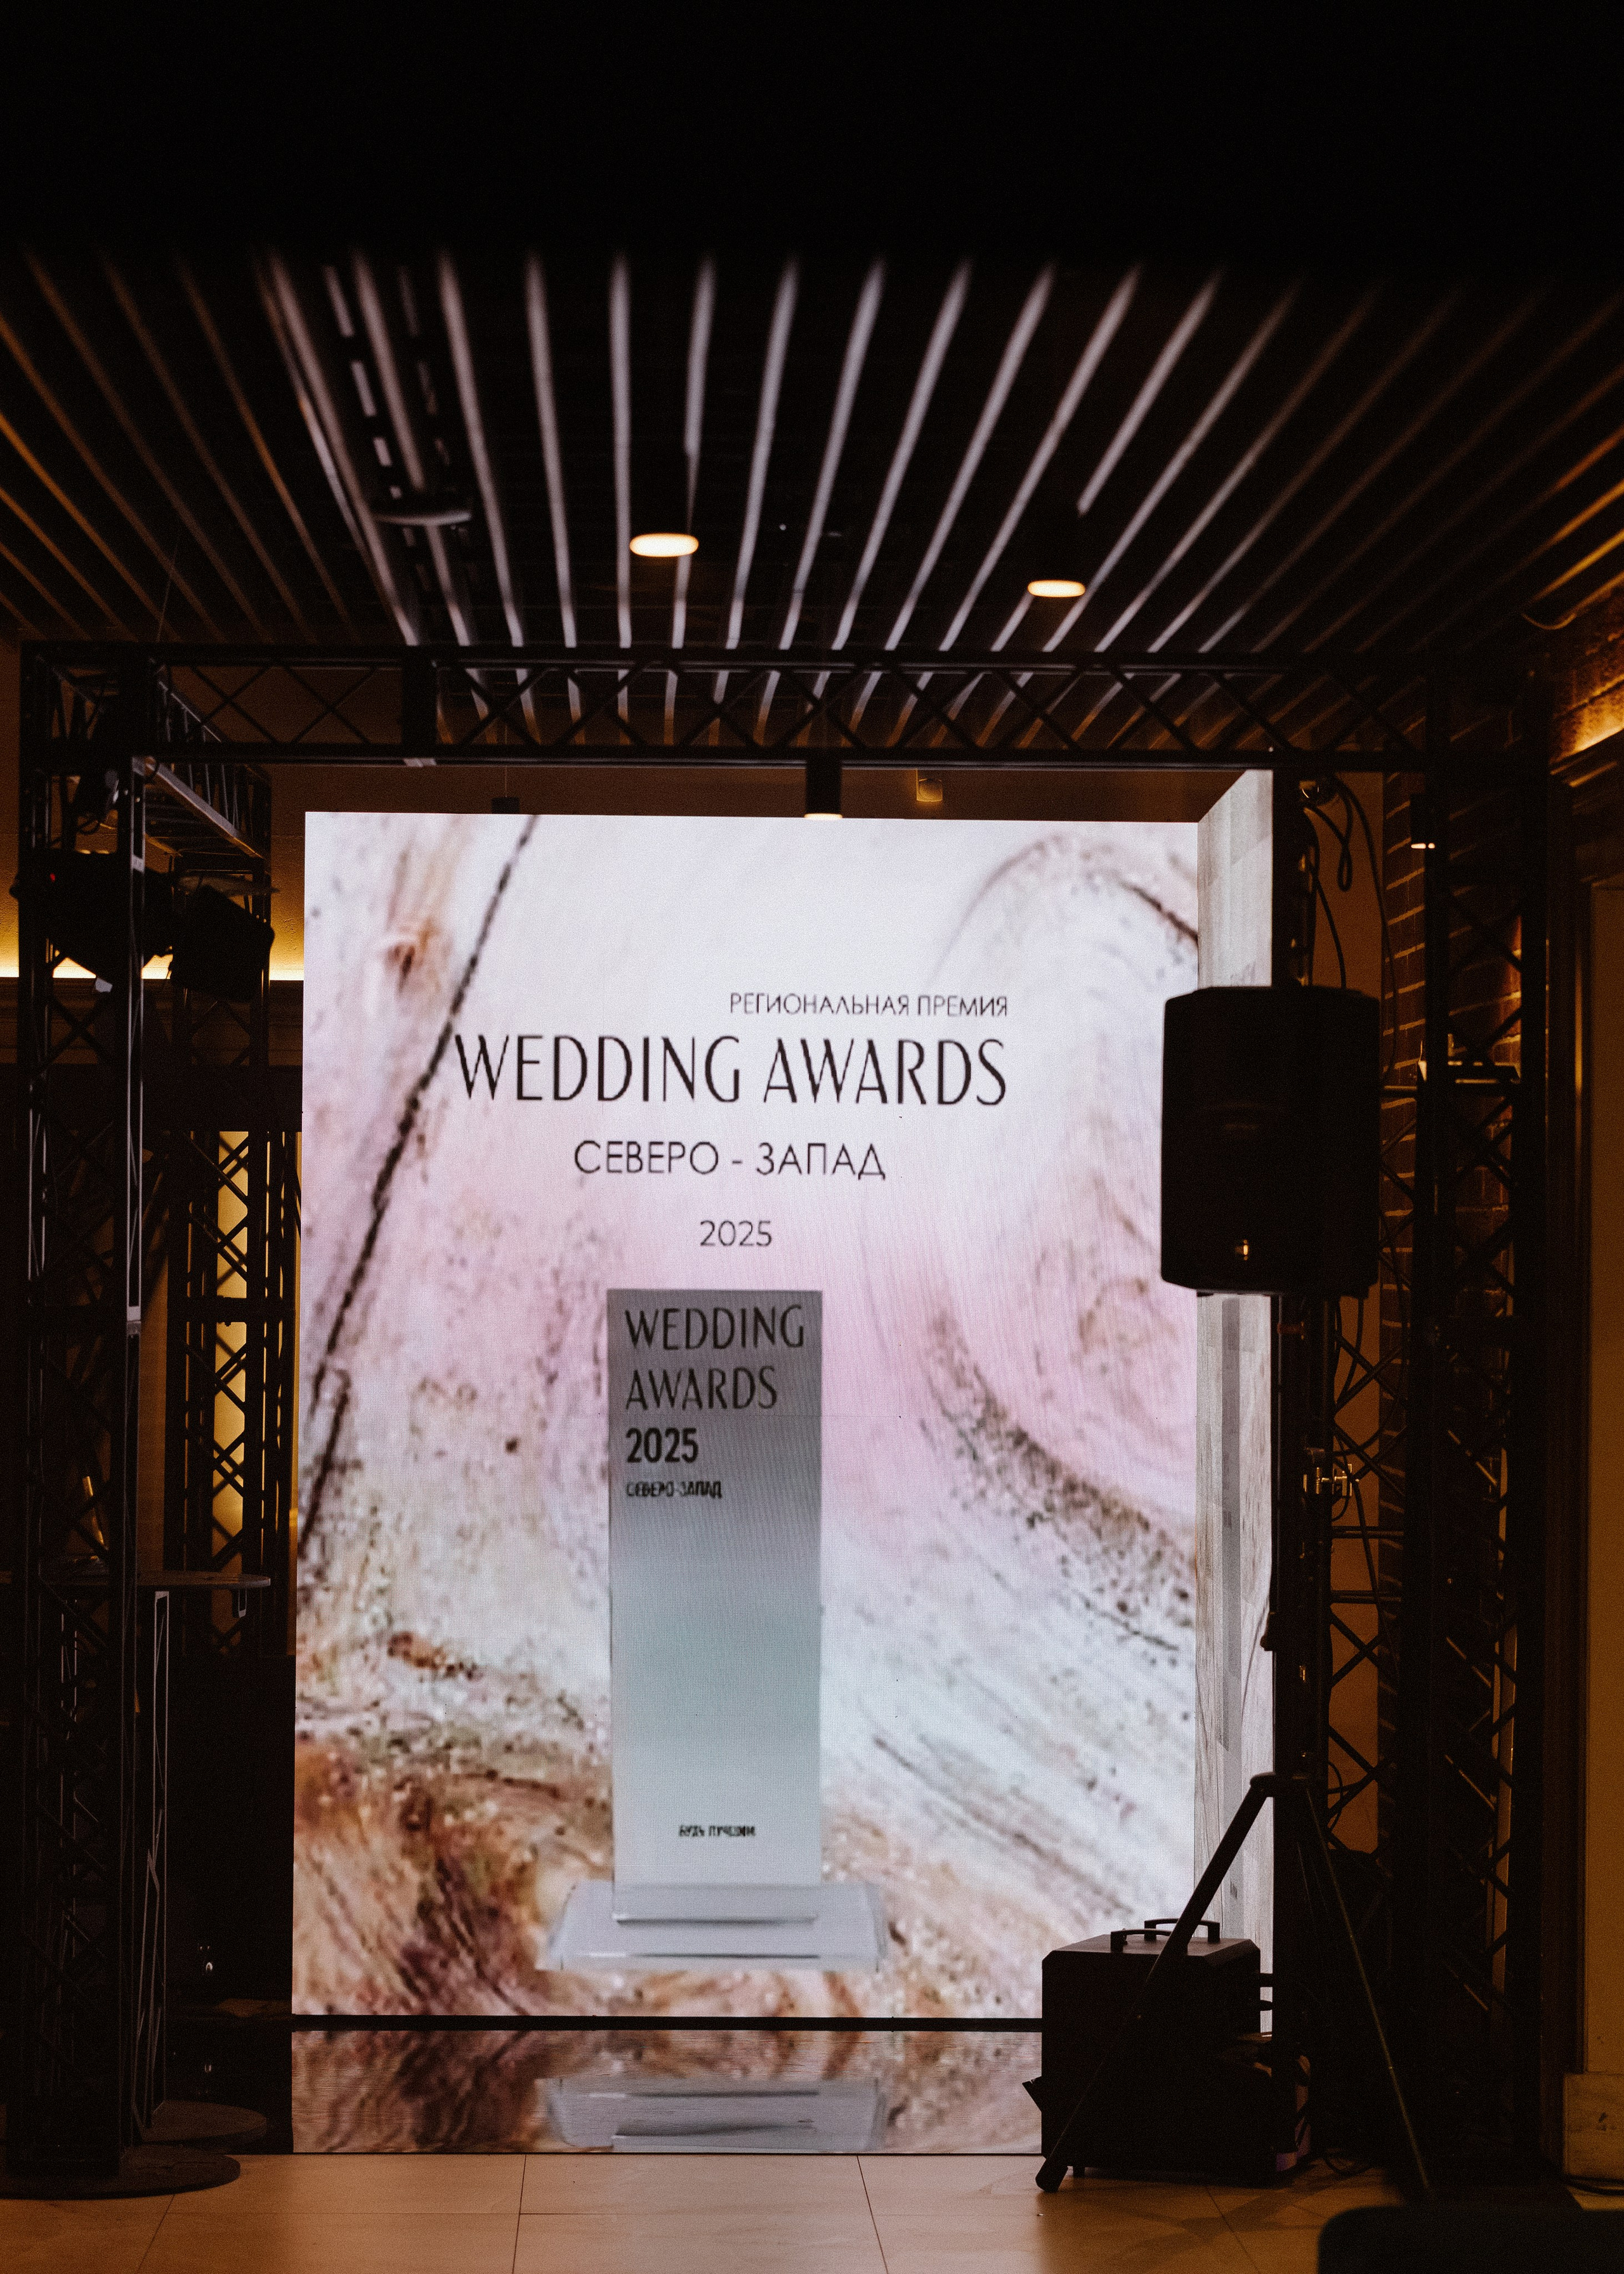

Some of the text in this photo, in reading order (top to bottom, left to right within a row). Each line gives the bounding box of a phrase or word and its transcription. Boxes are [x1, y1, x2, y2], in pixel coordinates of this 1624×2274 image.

[730, 992, 1008, 1017] РЕГИОНАЛЬНАЯ ПРЕМИЯ
[454, 1033, 1007, 1106] WEDDING AWARDS
[573, 1139, 720, 1175] СЕВЕРО
[755, 1142, 887, 1180] ЗАПАД
[699, 1220, 773, 1248] 2025
[624, 1304, 805, 1351] WEDDING
[625, 1365, 778, 1411] AWARDS
[625, 1427, 700, 1464] 2025
